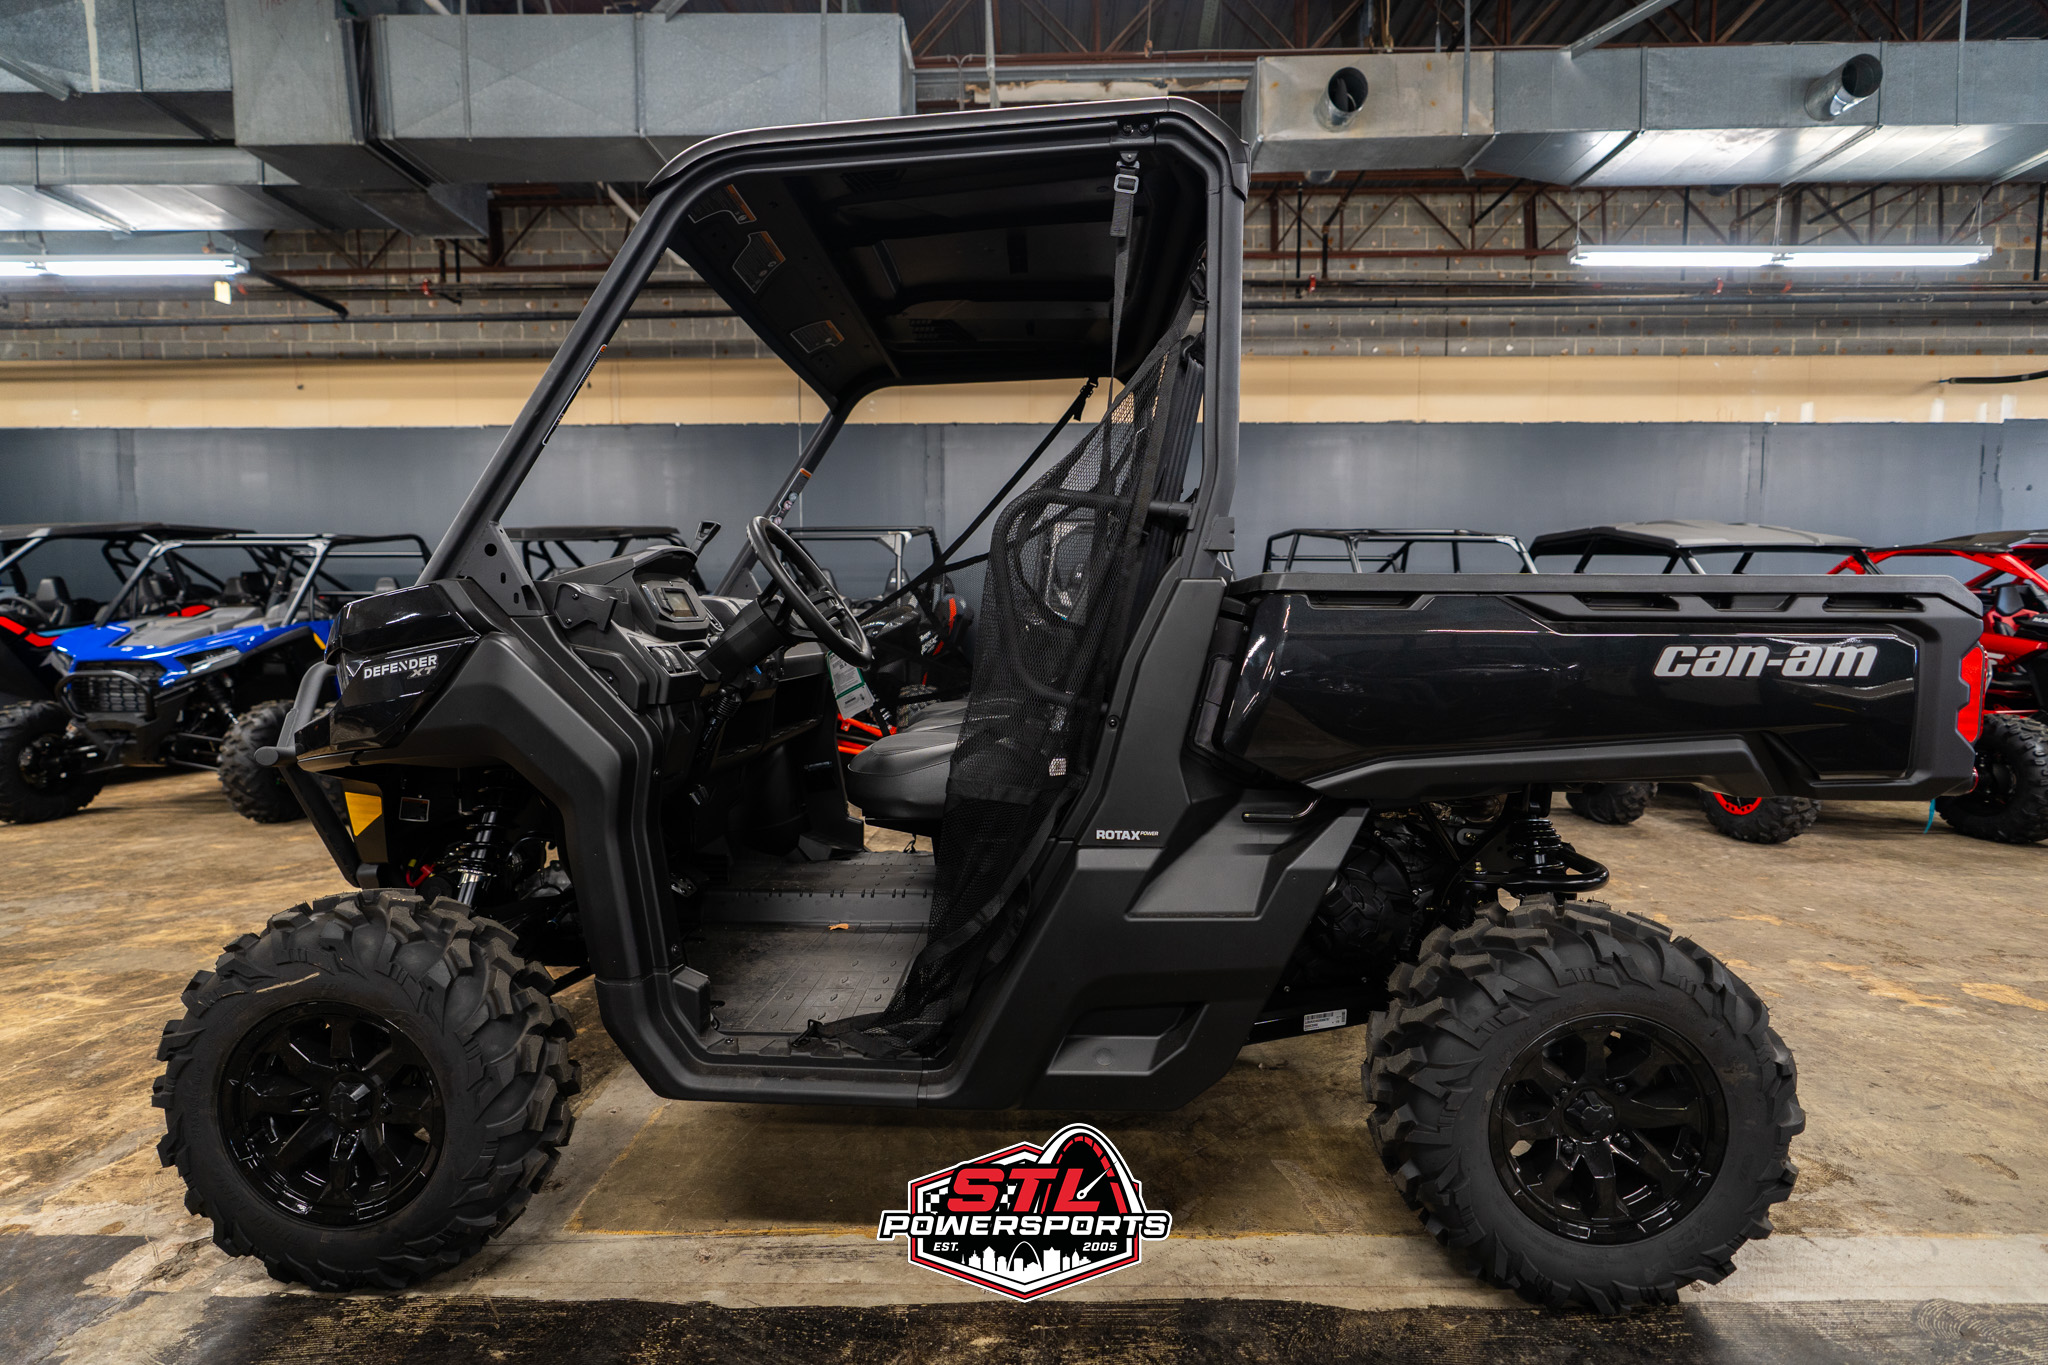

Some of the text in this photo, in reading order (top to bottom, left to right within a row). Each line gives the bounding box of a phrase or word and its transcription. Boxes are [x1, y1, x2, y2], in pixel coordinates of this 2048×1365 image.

[363, 655, 438, 679] DEFENDER
[1653, 645, 1878, 677] can-am
[410, 666, 436, 678] XT
[1096, 829, 1141, 841] ROTAX
